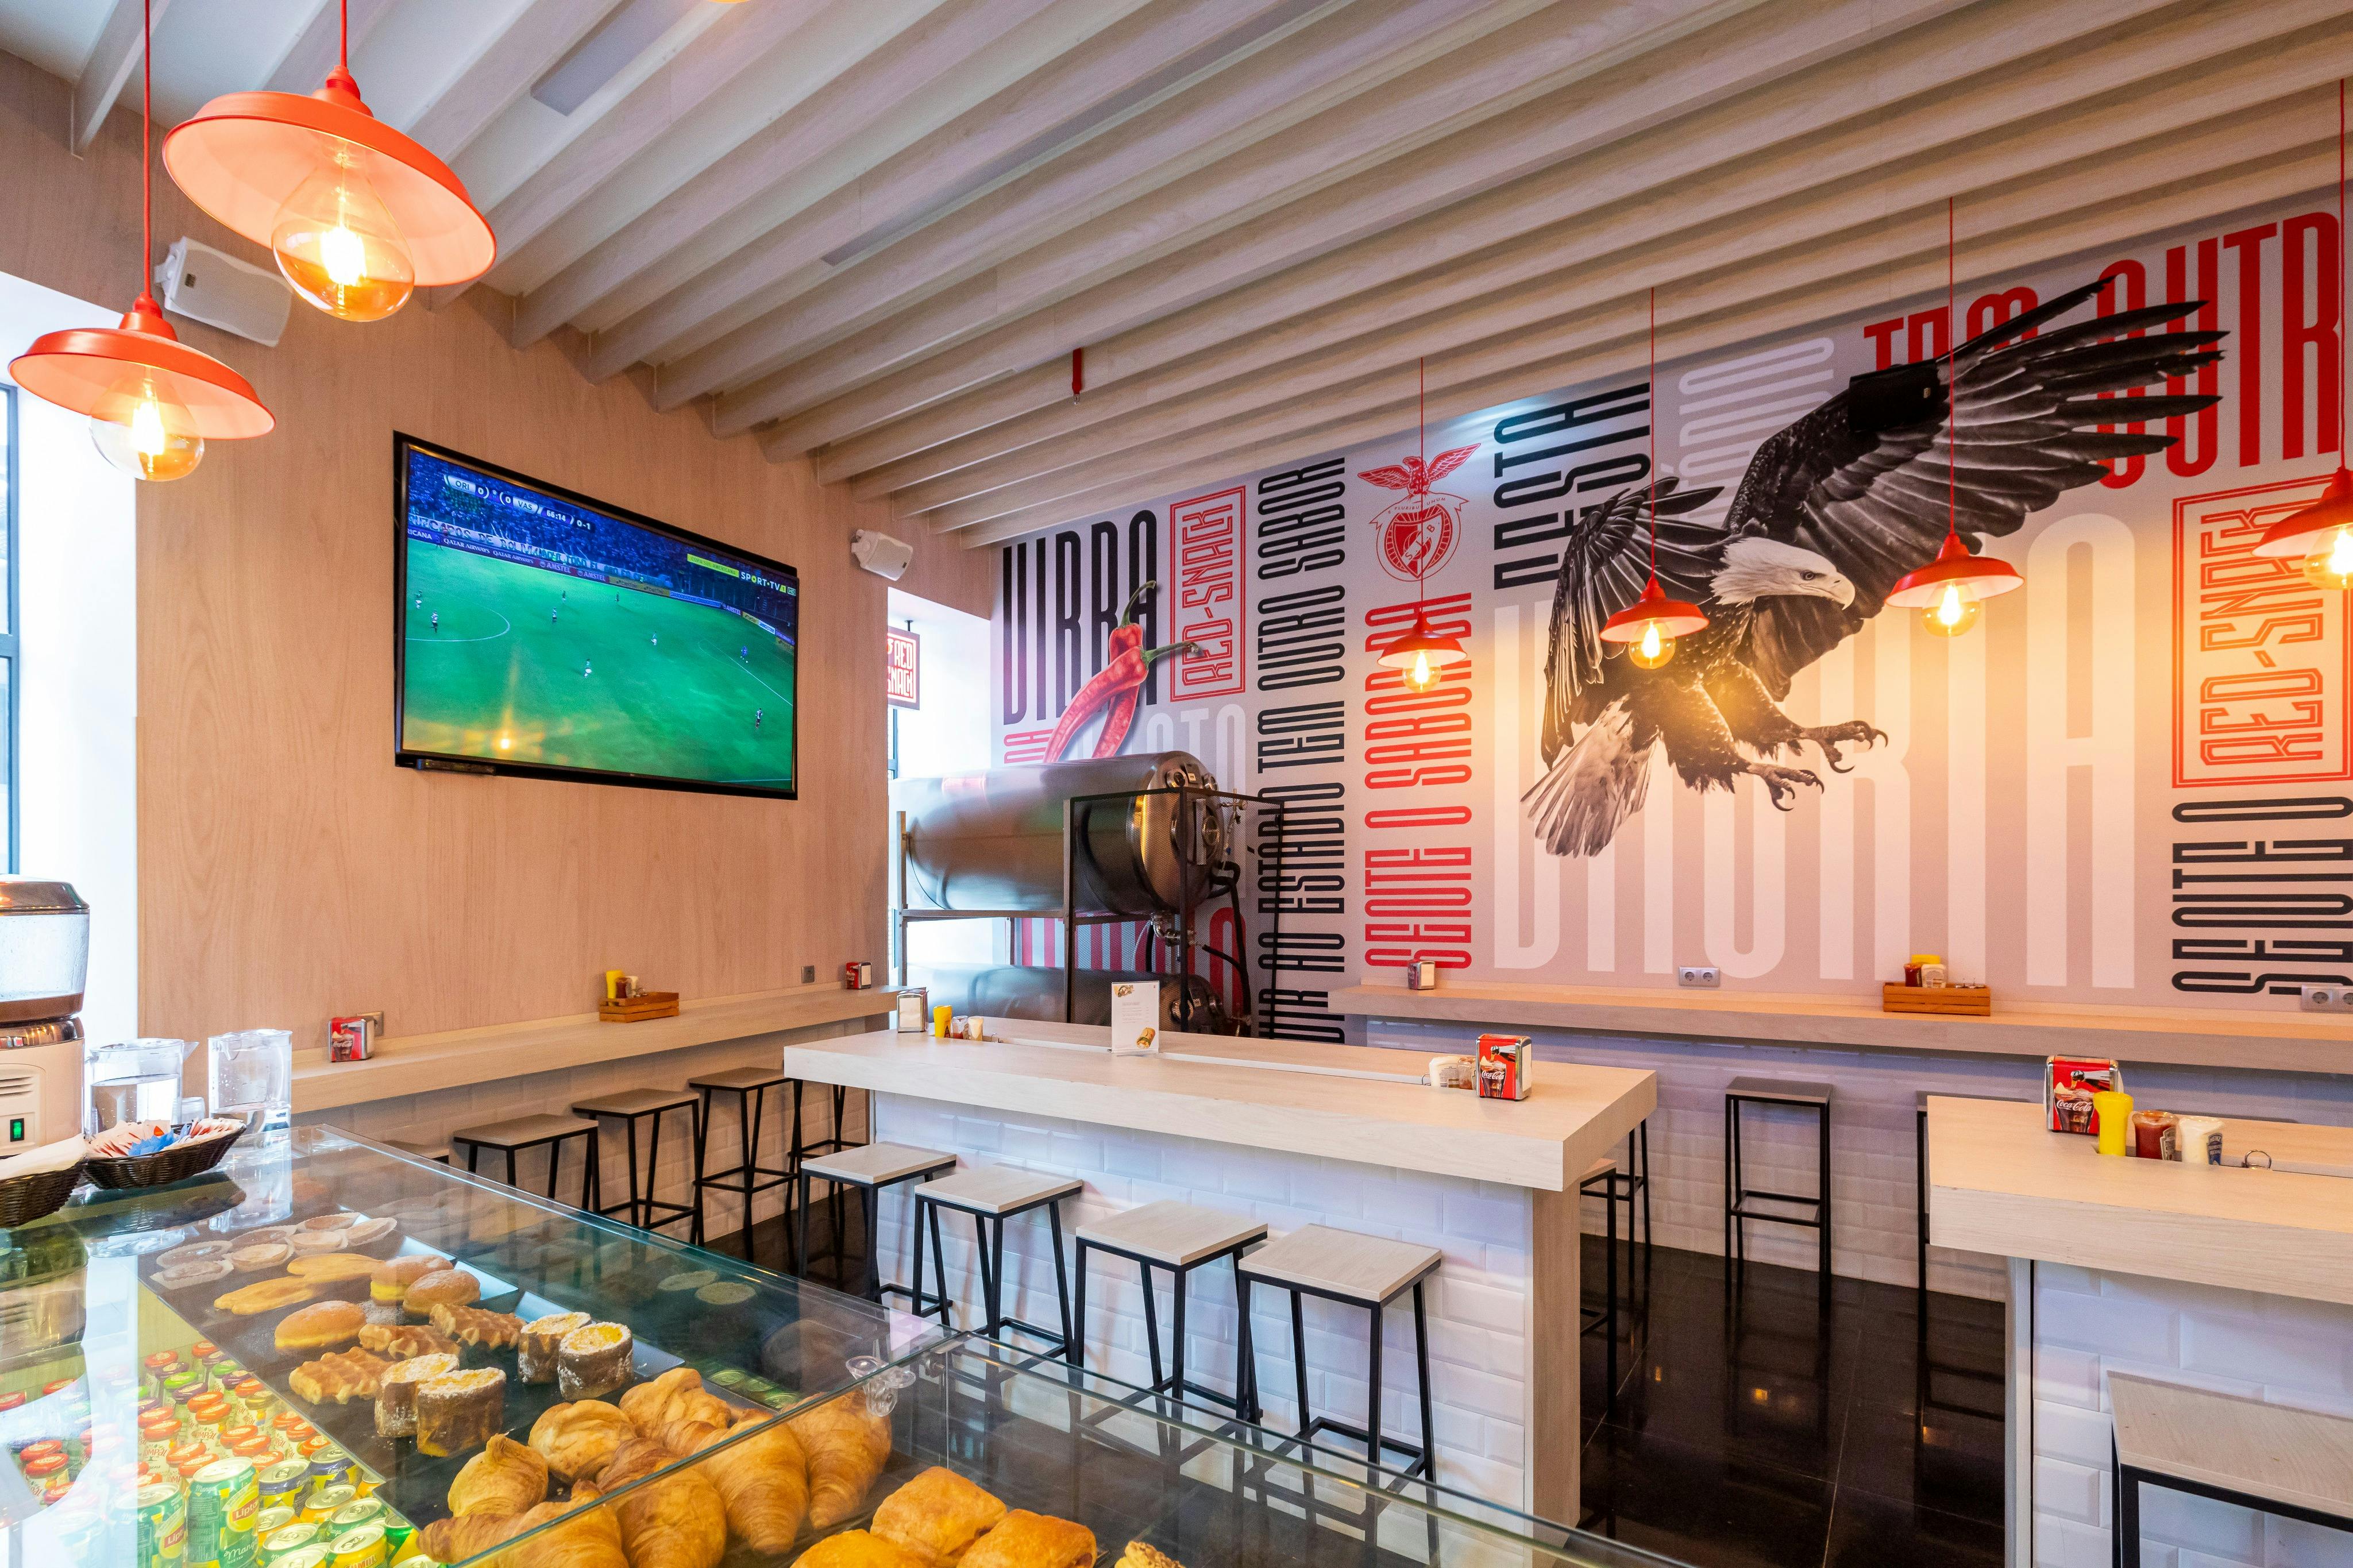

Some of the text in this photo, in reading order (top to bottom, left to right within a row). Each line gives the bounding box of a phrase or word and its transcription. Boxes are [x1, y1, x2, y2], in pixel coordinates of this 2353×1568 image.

[455, 480, 469, 492] ORI
[518, 500, 533, 511] VAS
[1257, 457, 1346, 580] SABOR
[546, 563, 571, 574] AMSTEL
[584, 570, 605, 582] AMSTEL
[1257, 584, 1346, 692] OUTRO
[894, 640, 913, 670] RED
[1257, 701, 1345, 774] TEM
[1364, 805, 1472, 829] O
[1364, 847, 1472, 969] SENTE
[2171, 796, 2353, 995] SENTE O
[1257, 932, 1345, 972] AO
[1482, 1070, 1505, 1080] Coca-Cola
[2056, 1099, 2093, 1112] Coca-Cola
[327, 1465, 348, 1475] Limão
